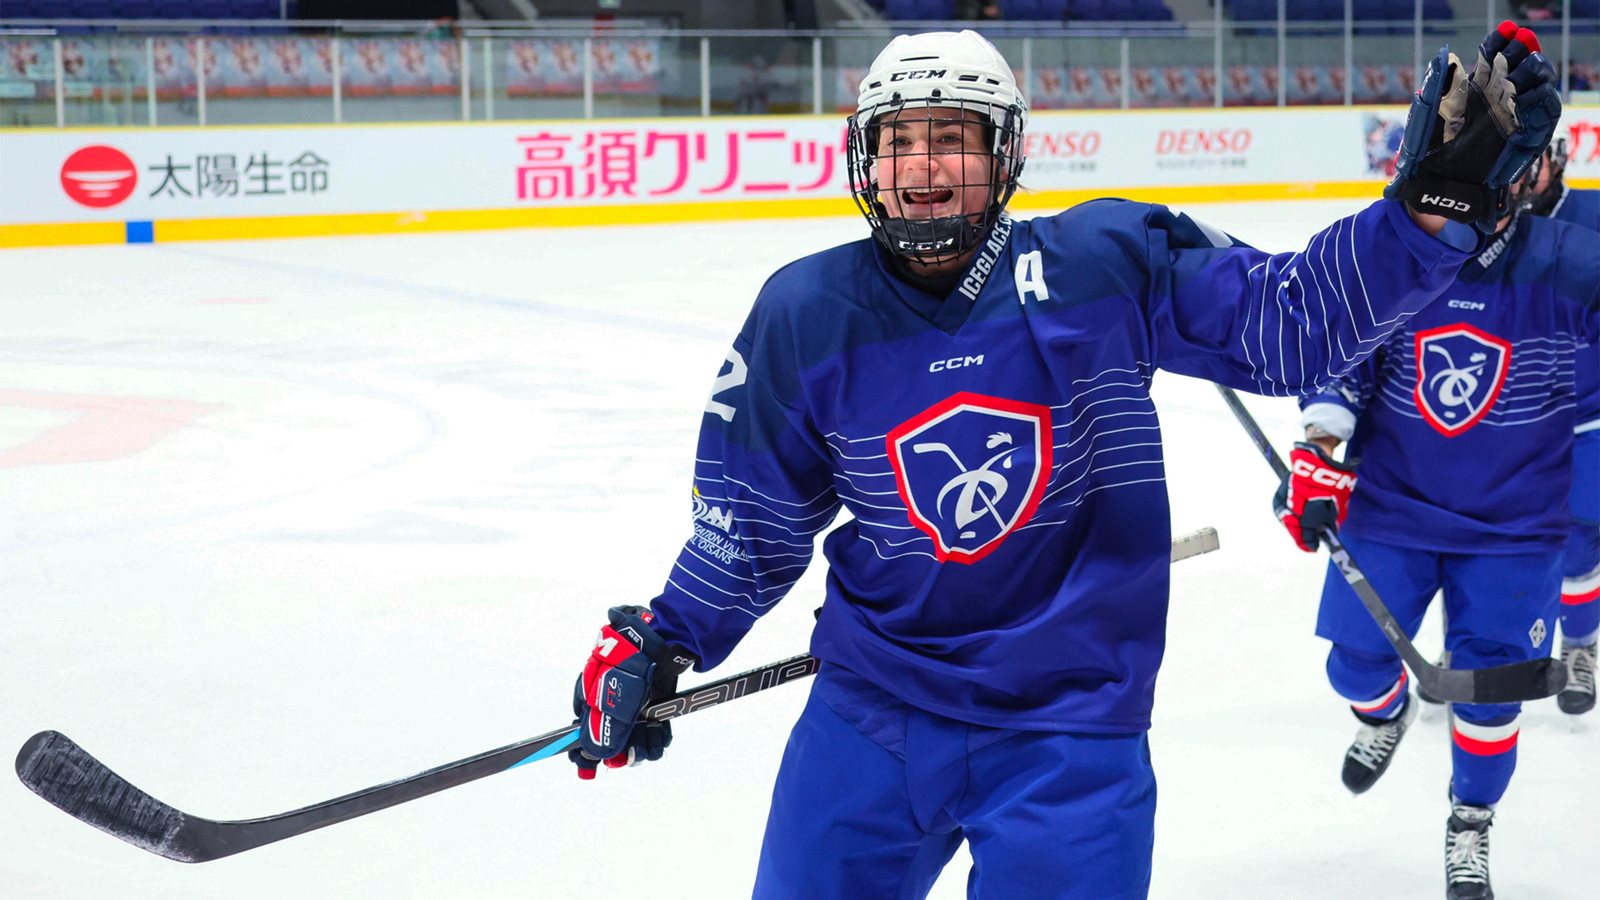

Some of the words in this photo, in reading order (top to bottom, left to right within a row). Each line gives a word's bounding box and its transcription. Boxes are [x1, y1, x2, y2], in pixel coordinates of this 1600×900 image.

[890, 69, 947, 82] CCM
[1018, 129, 1102, 159] ENSO
[1155, 127, 1253, 156] DENSO
[148, 150, 330, 199] 太陽生命
[1420, 194, 1471, 213] CCM
[1015, 250, 1050, 305] A
[1447, 299, 1486, 312] CCM
[928, 354, 984, 373] CCM
[1293, 458, 1358, 492] CCM
[603, 714, 612, 747] CCM
